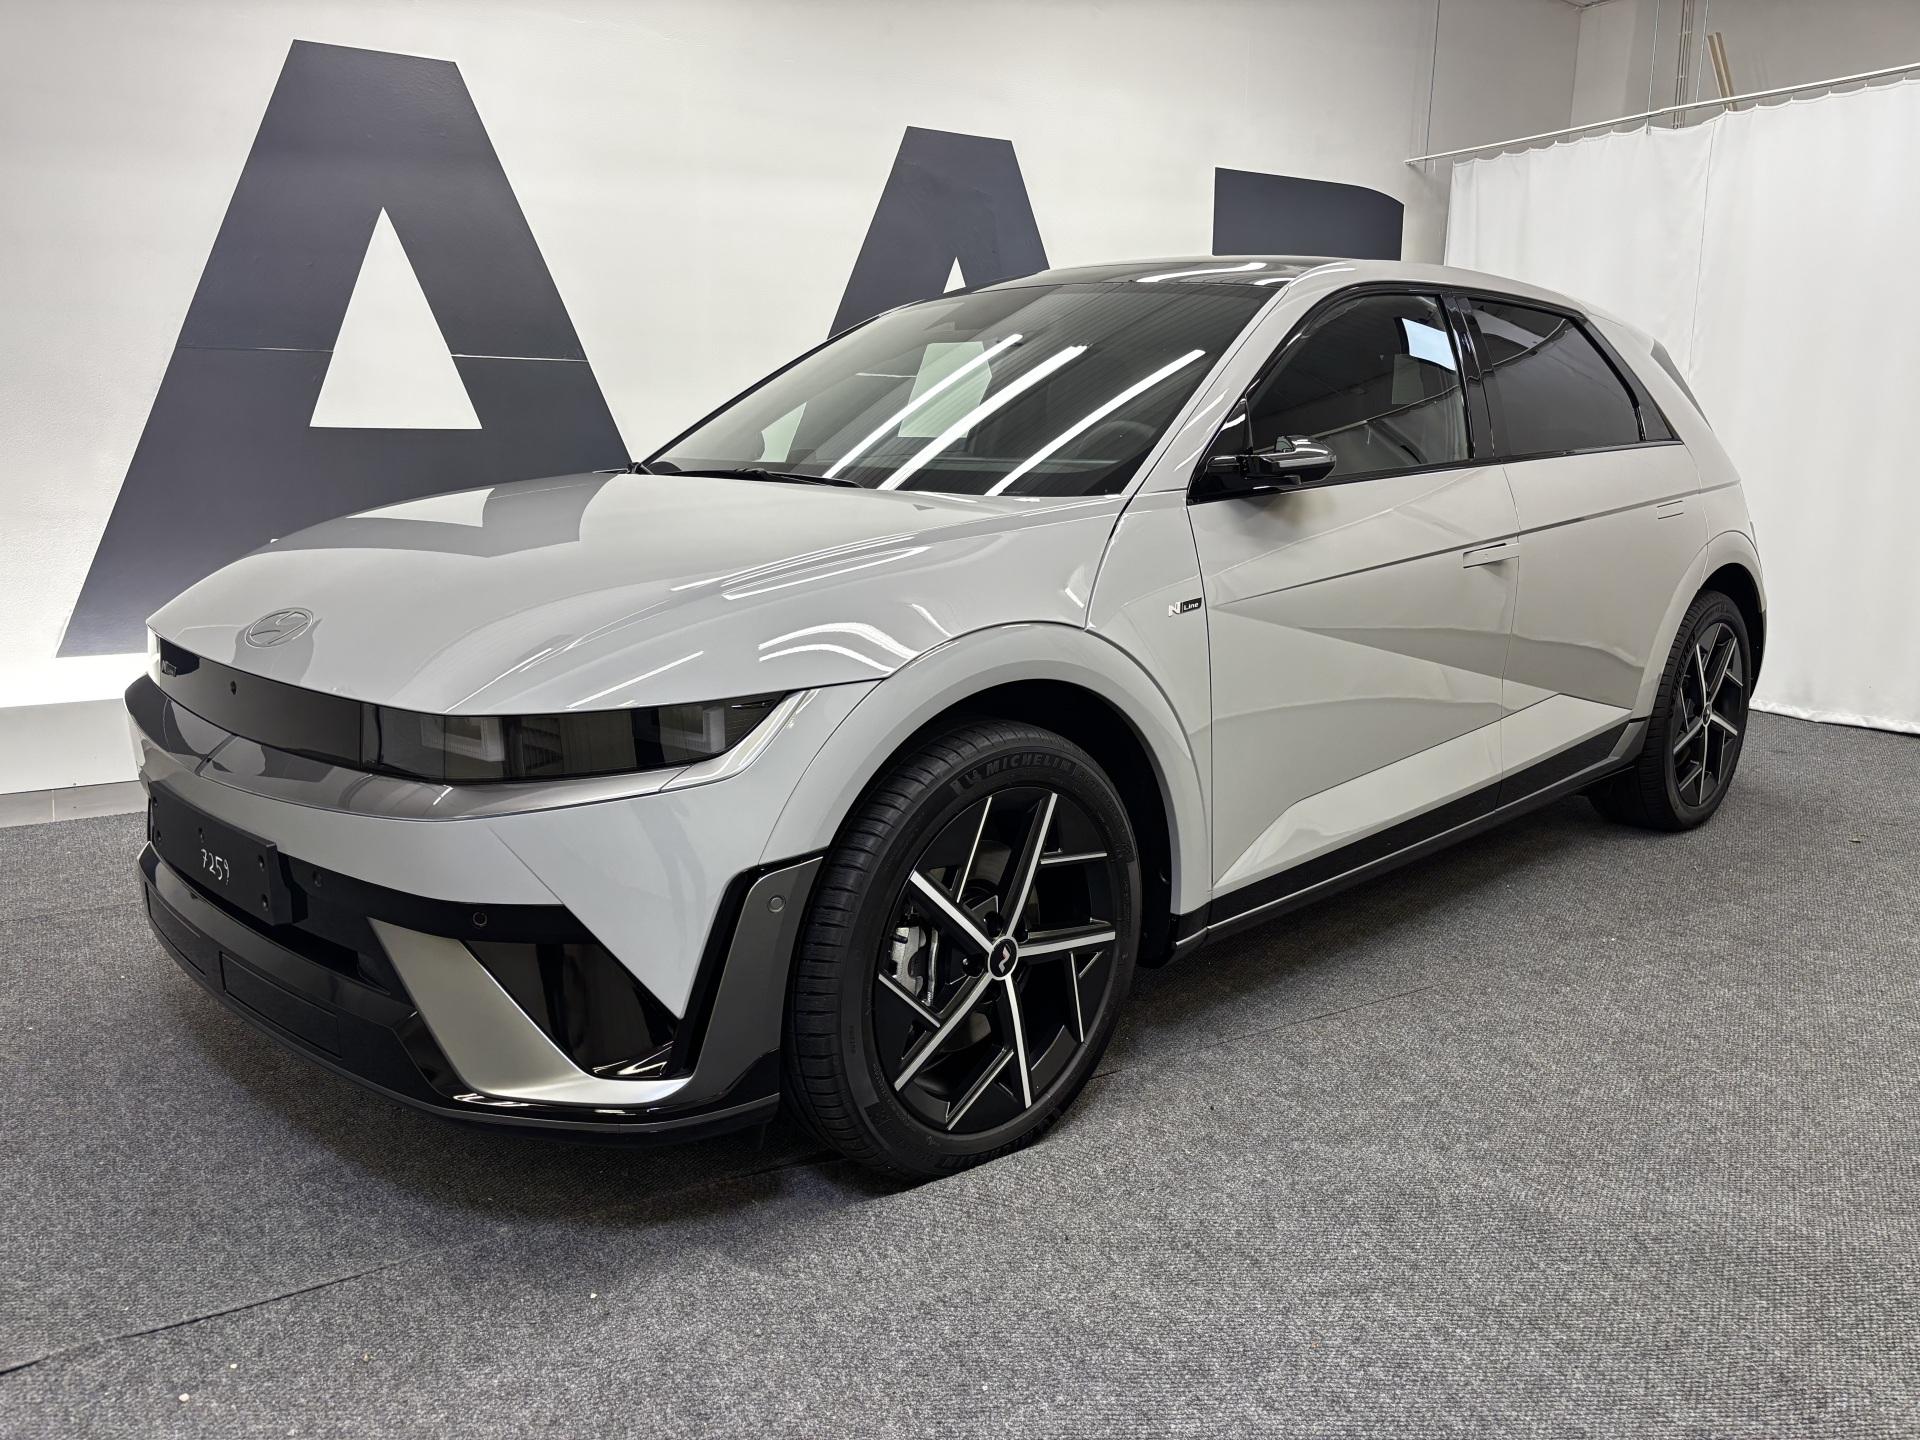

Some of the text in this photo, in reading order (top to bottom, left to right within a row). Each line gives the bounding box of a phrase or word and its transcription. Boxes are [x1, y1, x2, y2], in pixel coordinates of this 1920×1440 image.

[1168, 601, 1199, 617] N Line
[986, 751, 1073, 777] MICHELIN
